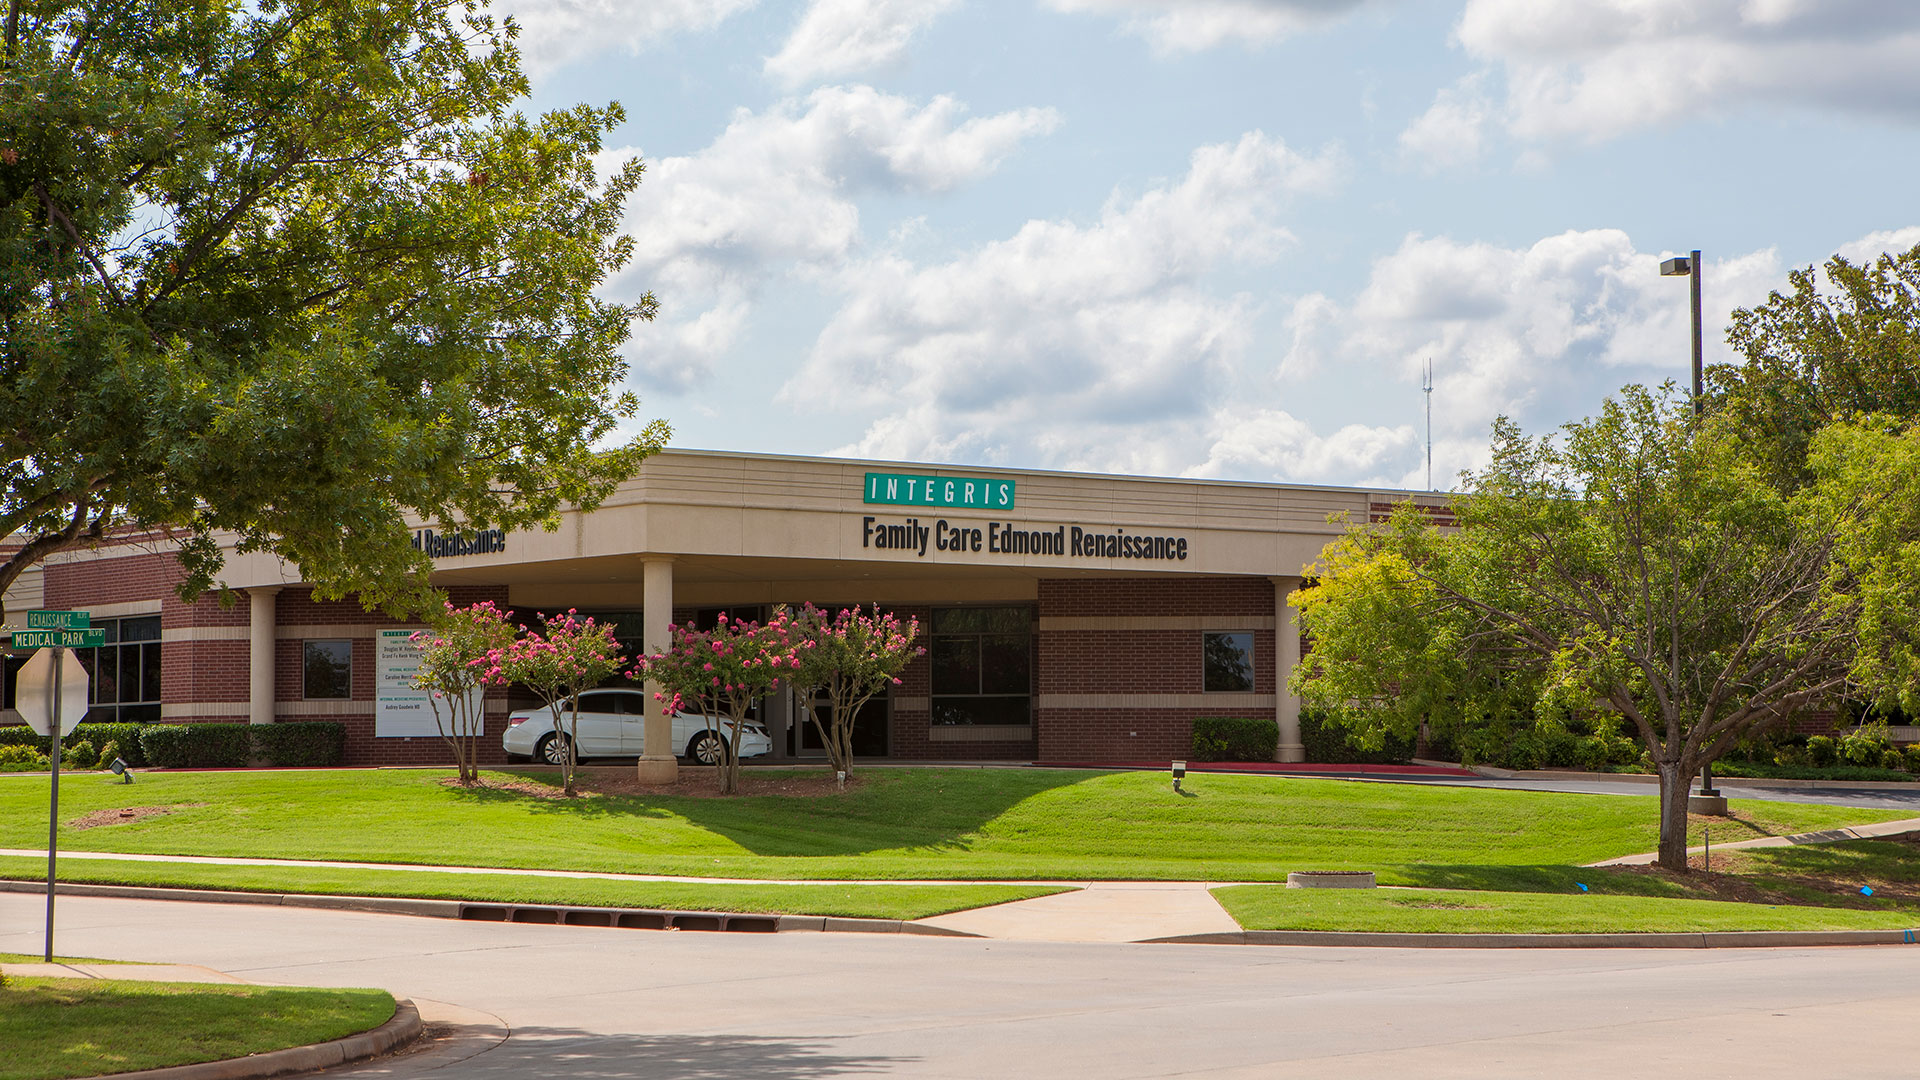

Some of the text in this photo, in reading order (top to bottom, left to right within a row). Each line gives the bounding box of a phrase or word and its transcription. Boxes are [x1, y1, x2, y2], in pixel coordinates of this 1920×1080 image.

[871, 477, 1009, 506] INTEGRIS
[863, 516, 1188, 561] Family Care Edmond Renaissance
[29, 613, 72, 627] RENAISSANCE
[15, 629, 103, 647] MEDICAL PARK BLVD
